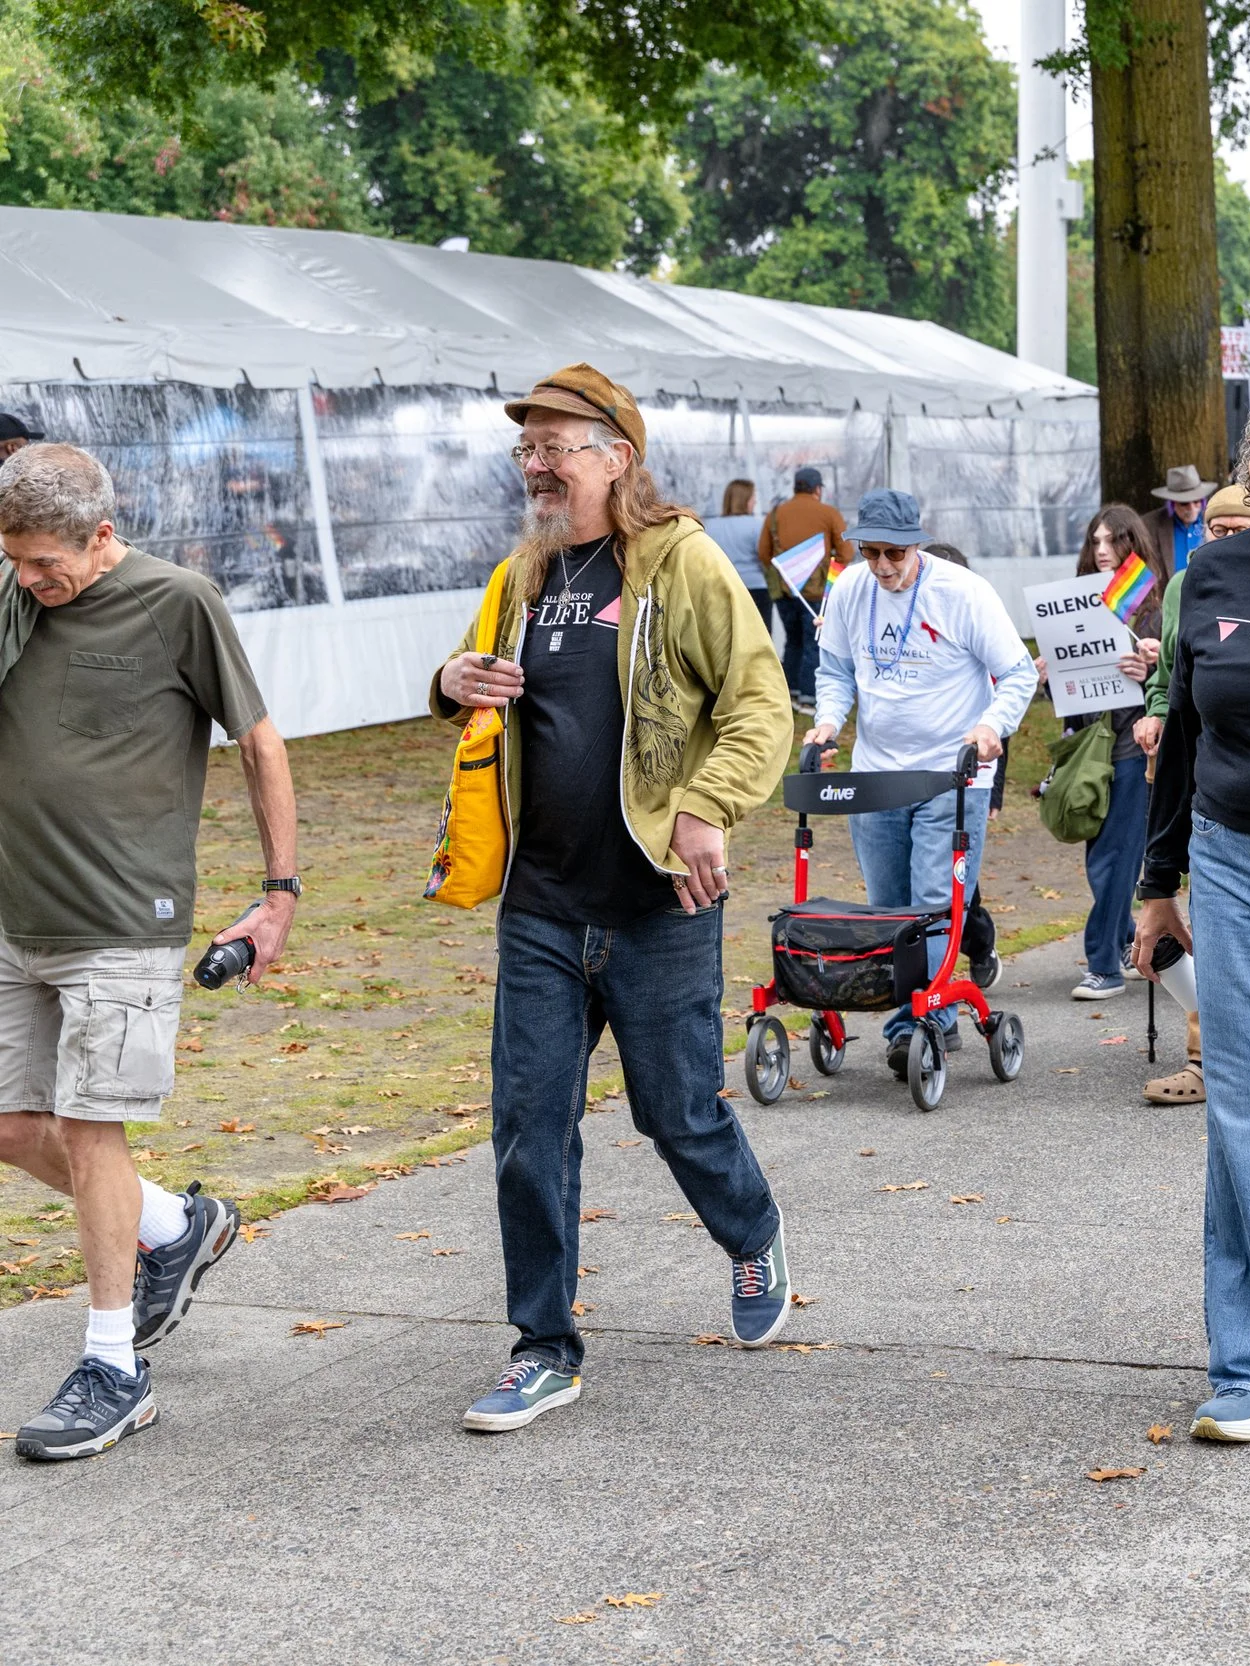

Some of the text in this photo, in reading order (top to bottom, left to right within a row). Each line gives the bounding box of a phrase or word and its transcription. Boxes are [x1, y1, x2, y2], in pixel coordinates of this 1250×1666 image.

[581, 593, 593, 601] OF
[1036, 592, 1104, 618] SILENC
[537, 602, 590, 626] LIFE
[900, 648, 932, 658] WELL
[1055, 638, 1116, 660] DEATH
[1081, 680, 1124, 699] LIFE
[820, 785, 855, 801] drive
[927, 993, 942, 1007] F-22
